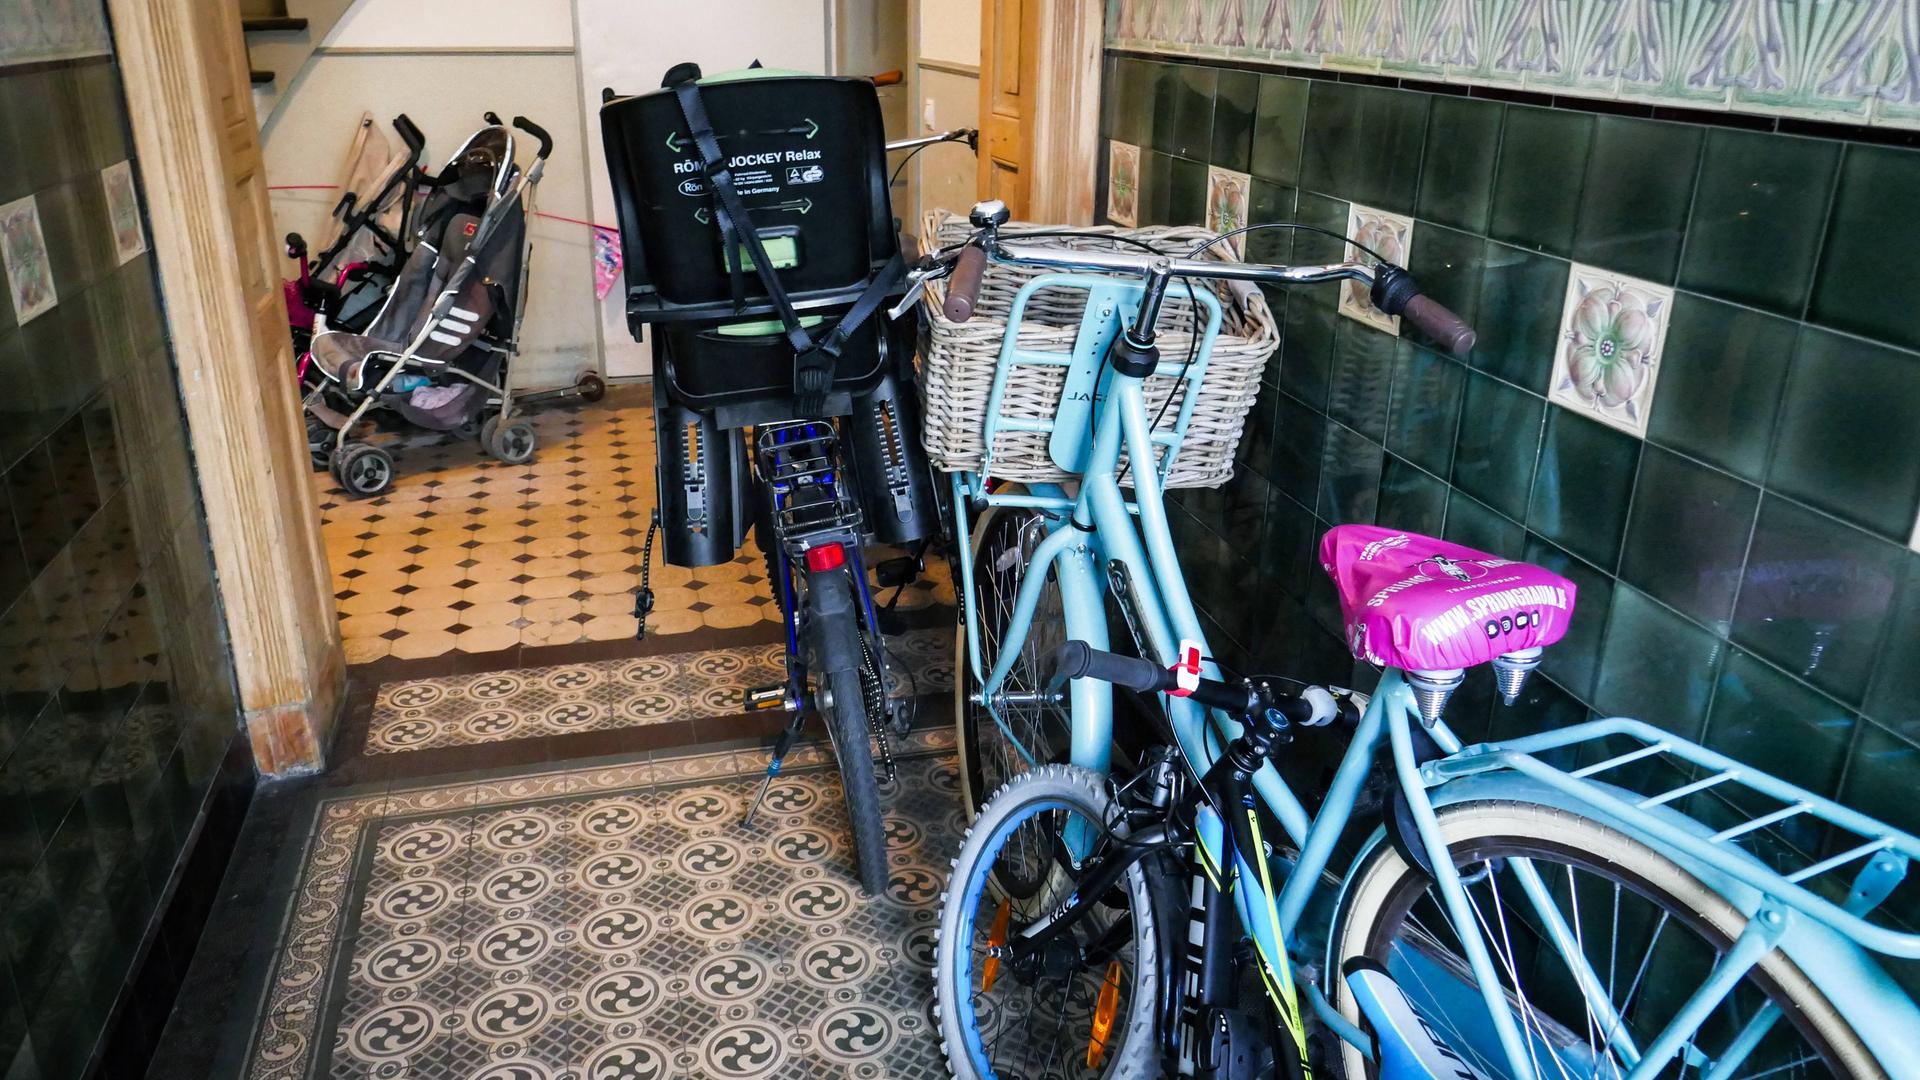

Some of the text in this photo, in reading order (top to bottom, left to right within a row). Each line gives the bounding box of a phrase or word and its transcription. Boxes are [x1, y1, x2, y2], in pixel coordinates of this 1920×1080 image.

[728, 152, 782, 168] JOCKEY
[785, 149, 821, 162] Relax
[751, 184, 780, 195] Germany
